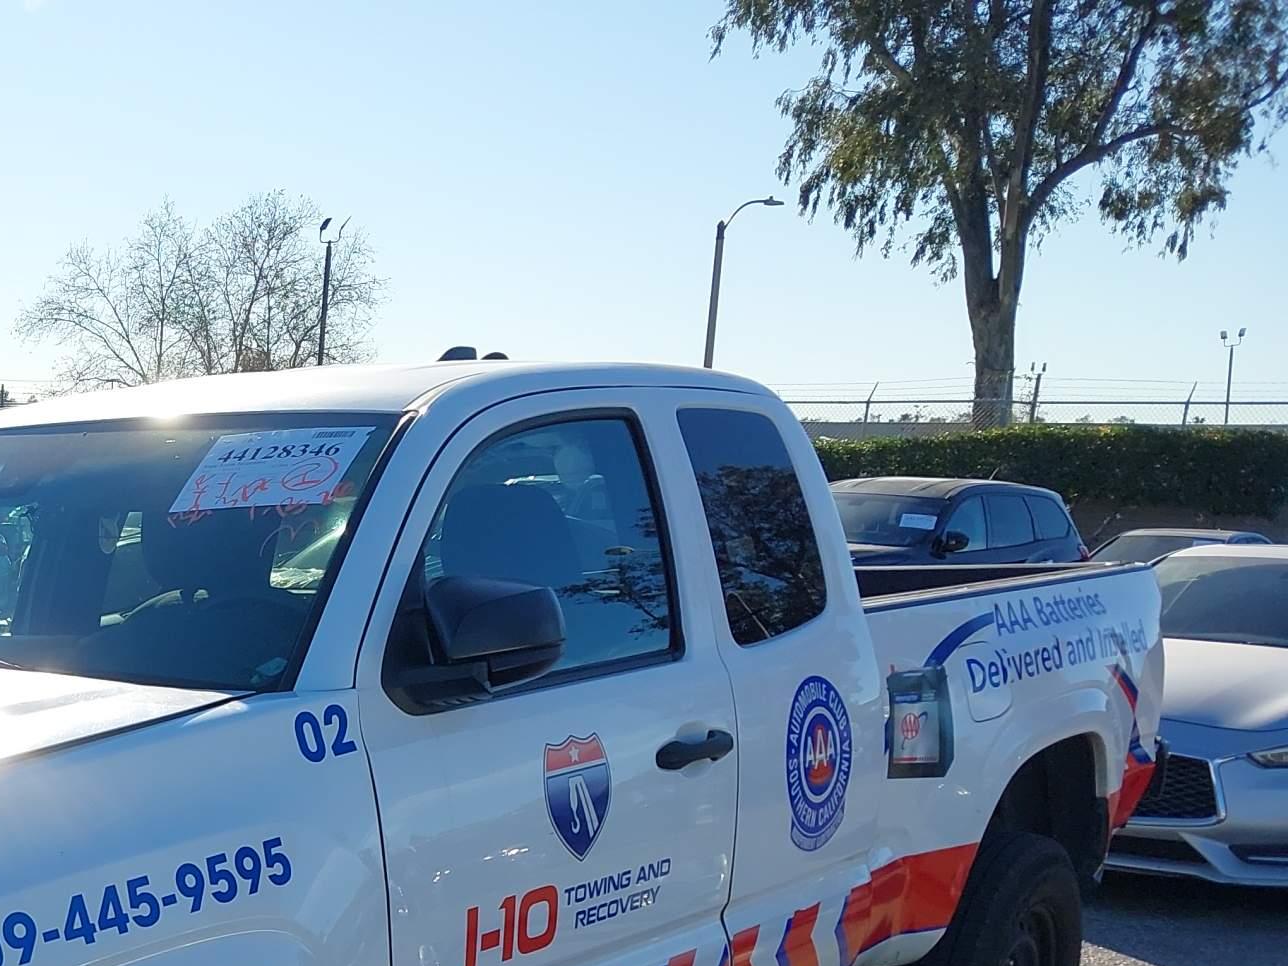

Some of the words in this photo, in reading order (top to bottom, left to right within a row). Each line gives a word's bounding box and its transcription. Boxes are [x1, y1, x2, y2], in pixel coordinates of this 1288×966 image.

[218, 442, 344, 463] 44128346
[993, 599, 1038, 636] AAA
[1032, 588, 1107, 626] Batteries
[966, 635, 1062, 693] Delivered
[1066, 627, 1097, 666] and
[295, 704, 357, 762] 02
[789, 681, 828, 747] AUTOMOBILE
[828, 690, 847, 731] CLUB
[805, 729, 836, 769] AAA
[788, 758, 817, 827] SOUTHERN
[818, 743, 851, 827] CALIFORNIA
[564, 869, 632, 906] TOWING
[635, 858, 672, 885] AND
[574, 885, 662, 929] RECOVERY
